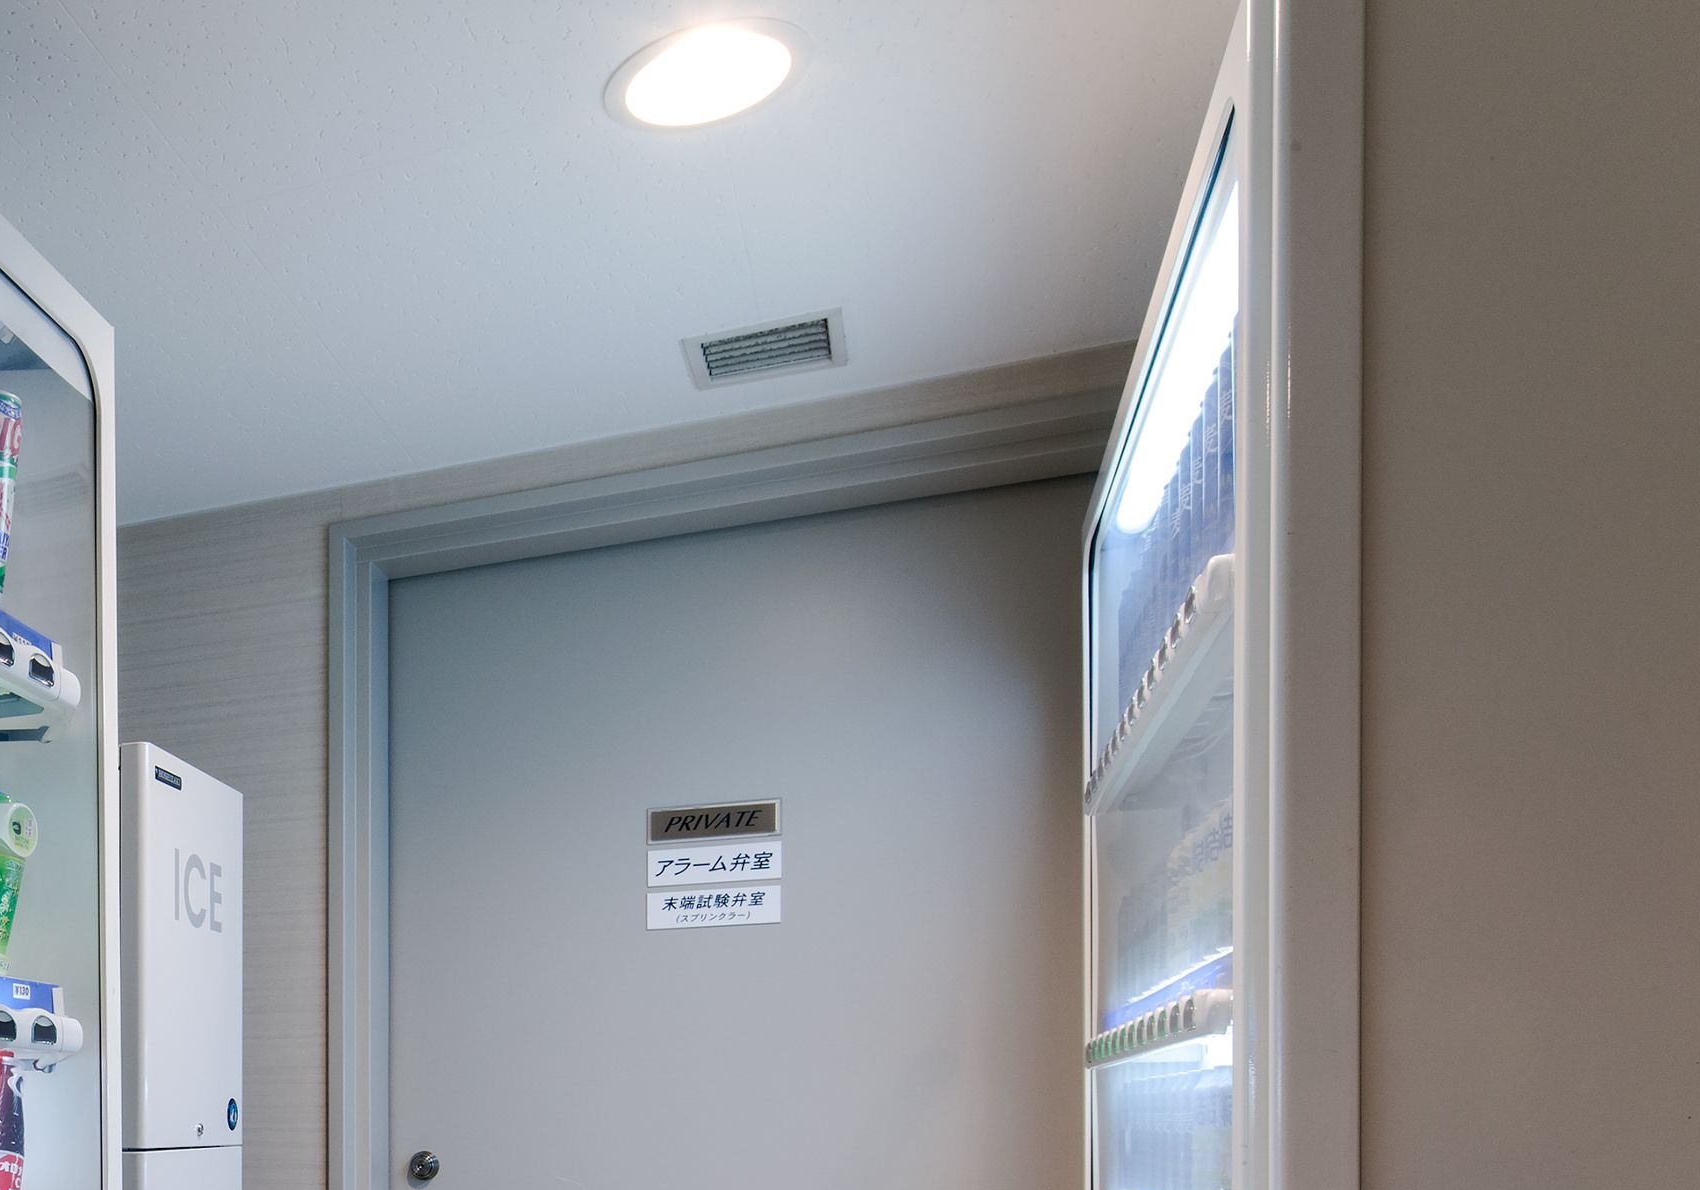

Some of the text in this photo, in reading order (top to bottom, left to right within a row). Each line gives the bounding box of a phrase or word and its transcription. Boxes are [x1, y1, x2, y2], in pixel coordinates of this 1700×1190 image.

[664, 809, 763, 833] PRIVATE
[655, 852, 773, 877] アラーム弁室
[174, 848, 222, 933] ICE
[662, 891, 766, 911] 末端試験弁室
[15, 986, 29, 996] ¥130
